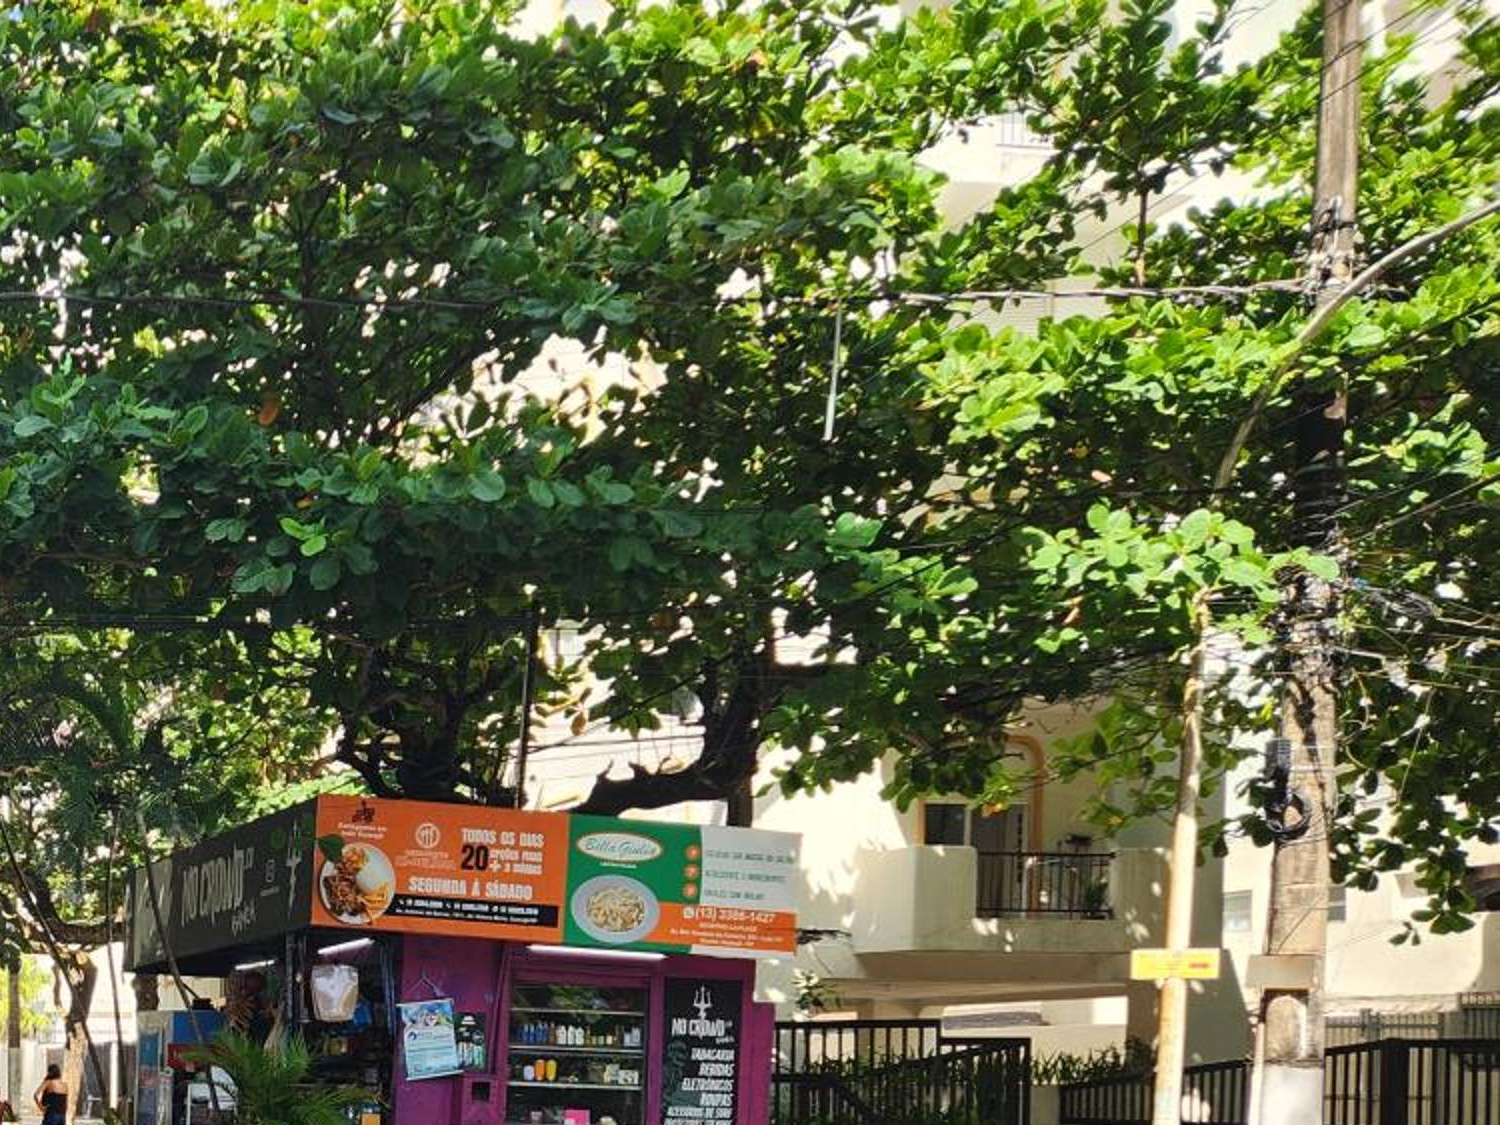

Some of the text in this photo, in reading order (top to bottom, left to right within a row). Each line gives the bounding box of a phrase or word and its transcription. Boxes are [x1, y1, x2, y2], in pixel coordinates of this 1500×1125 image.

[461, 828, 544, 847] TODOS OS DIAS
[461, 845, 489, 871] 20
[409, 876, 467, 896] SEGUNDA
[485, 879, 533, 900] SÁBADO
[696, 906, 717, 921] (13)
[672, 1017, 725, 1039] NO CROWD
[692, 1048, 735, 1060] TABACARIA
[699, 1062, 735, 1077] BEBIDAS
[700, 1092, 734, 1107] ROUPAS
